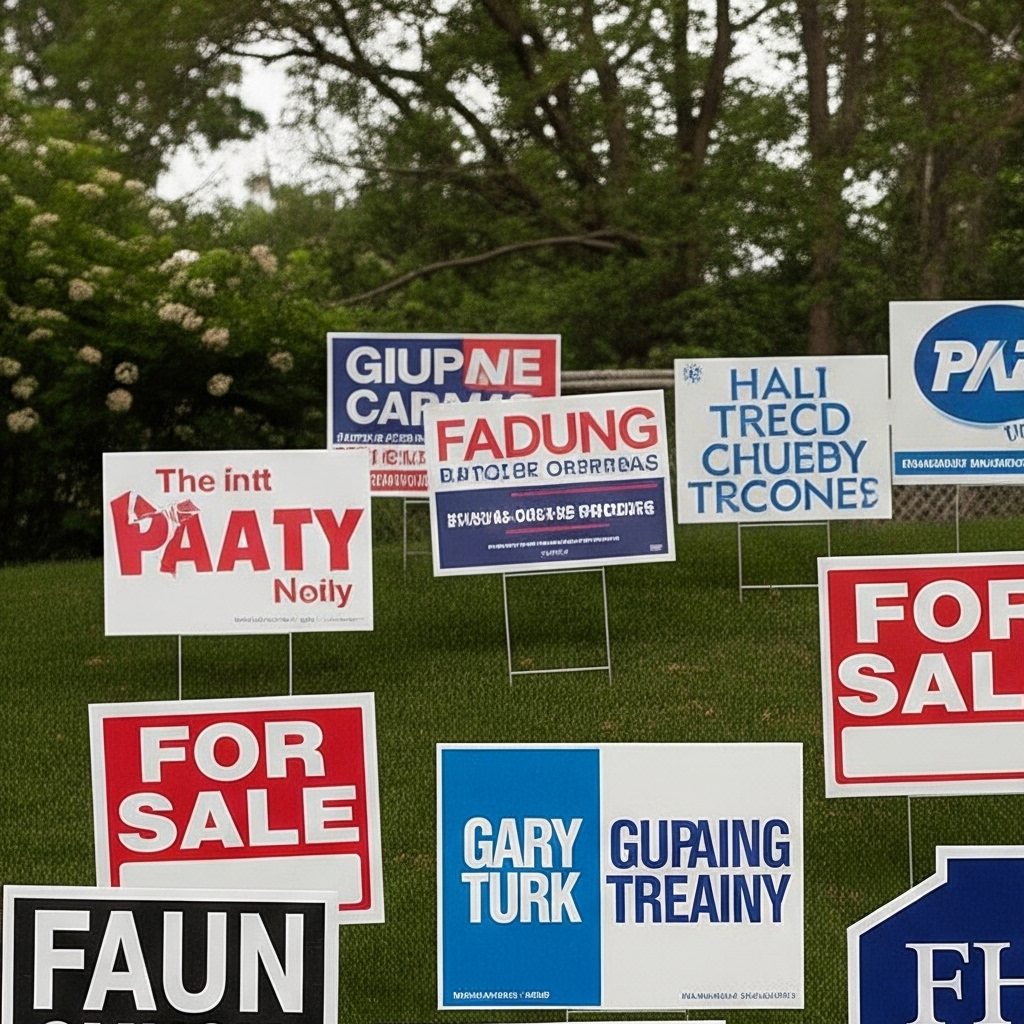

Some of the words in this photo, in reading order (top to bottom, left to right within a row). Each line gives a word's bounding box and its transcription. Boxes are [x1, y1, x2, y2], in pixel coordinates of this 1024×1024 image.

[730, 367, 827, 400] HALI
[436, 407, 658, 461] FADUNG
[709, 403, 850, 438] TRECD
[156, 469, 215, 493] The
[702, 440, 867, 476] CHUEBY
[274, 578, 353, 608] Noily
[139, 721, 326, 783] FOR
[118, 785, 360, 853] SALE
[463, 817, 583, 869] GARY
[610, 819, 791, 869] GUPAING
[461, 872, 583, 924] TURK
[606, 873, 792, 924] TREAINY
[33, 909, 304, 1013] FAUN
